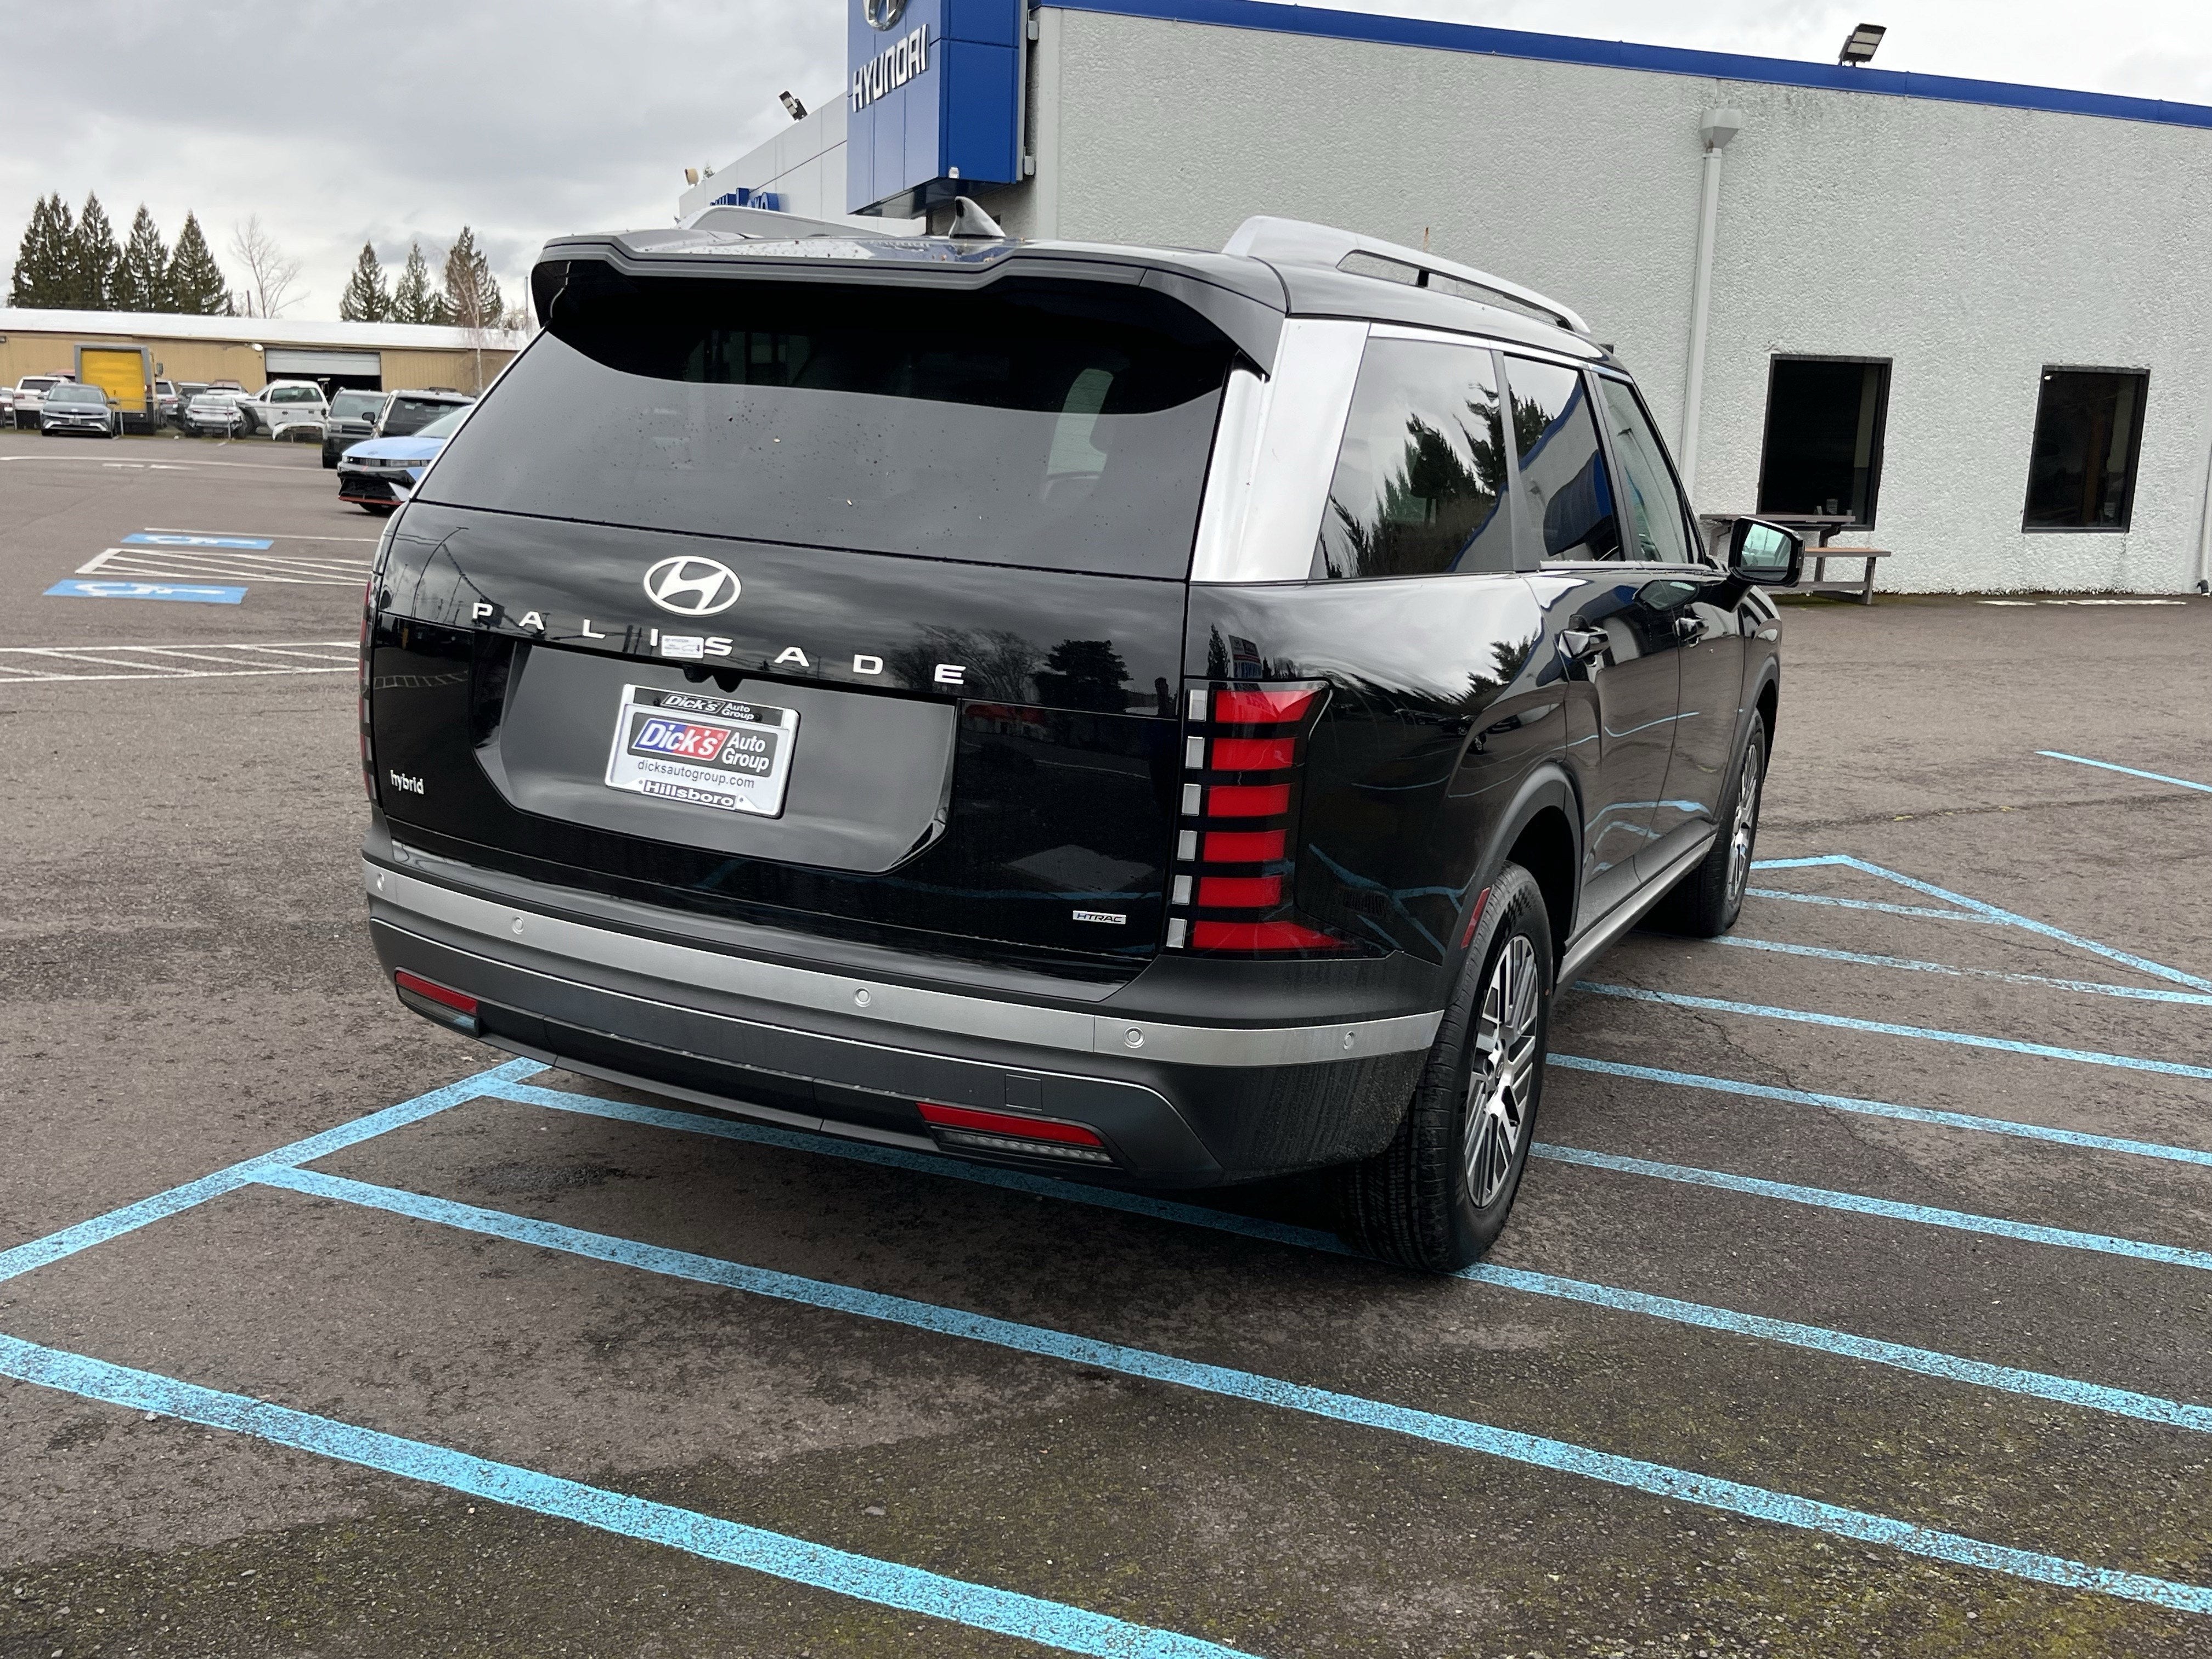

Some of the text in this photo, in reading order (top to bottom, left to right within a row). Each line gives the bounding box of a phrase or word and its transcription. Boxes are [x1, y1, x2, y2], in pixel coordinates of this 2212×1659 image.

[853, 24, 929, 112] HYUNDAI
[472, 602, 966, 685] PALISADE
[665, 695, 751, 713] Dick's Auto
[721, 708, 754, 720] Group
[639, 723, 766, 755] Dick's Auto
[721, 748, 770, 772] Group
[390, 769, 425, 795] hybrid
[637, 759, 755, 789] dicksautogroup.com
[645, 780, 734, 806] Hillsboro
[1077, 912, 1122, 923] HTRAC
